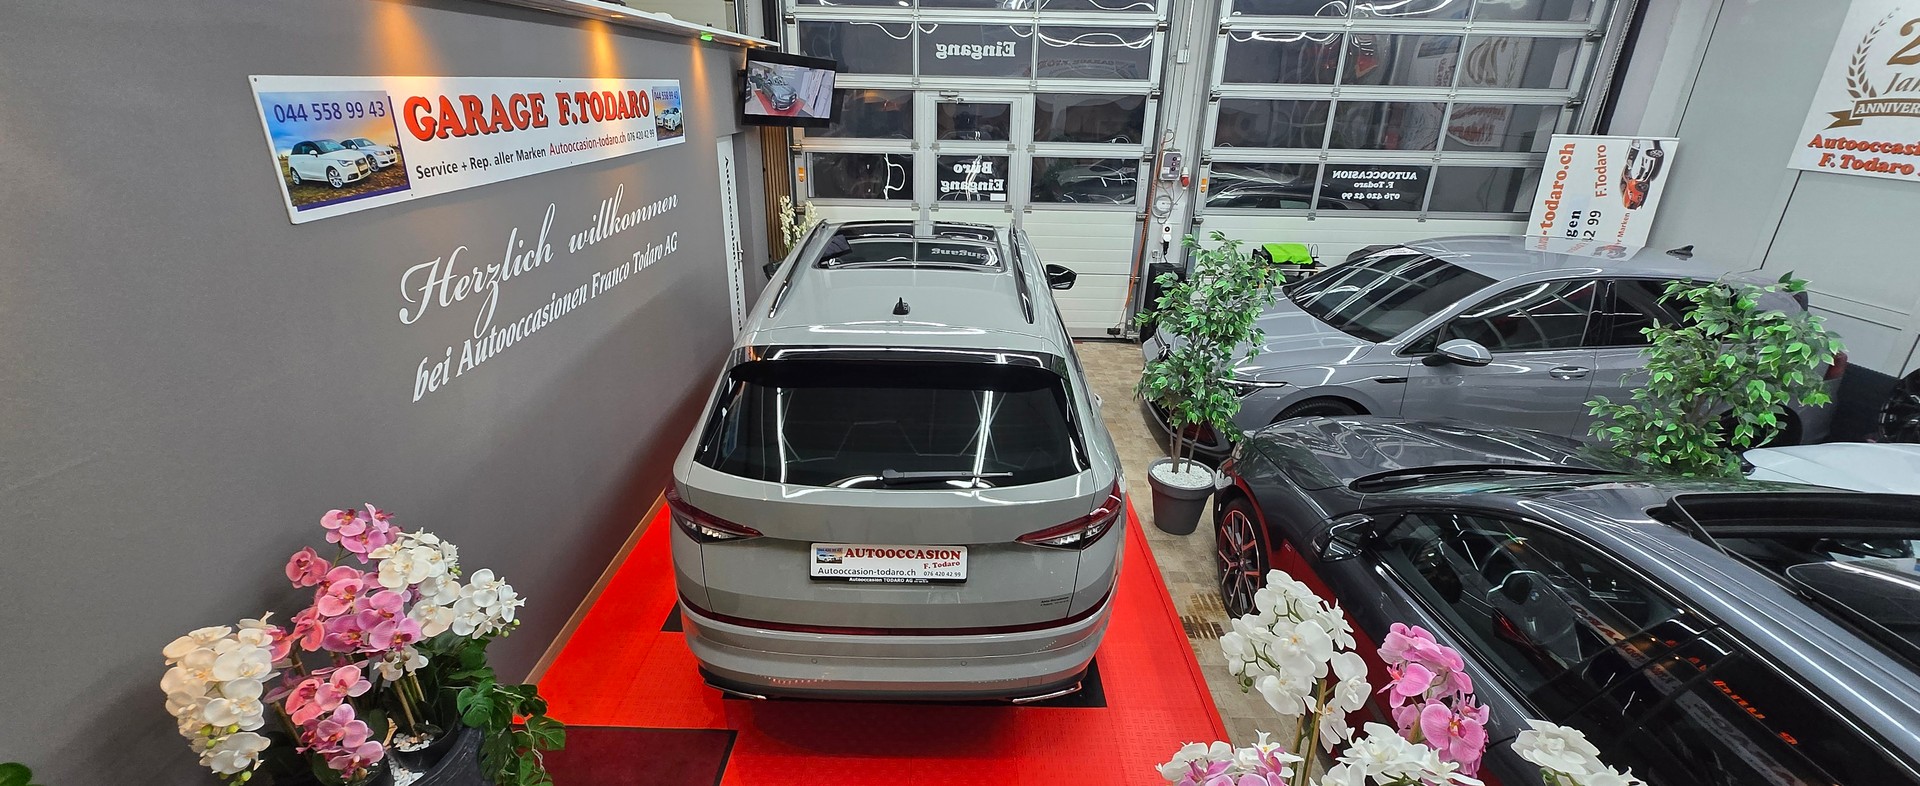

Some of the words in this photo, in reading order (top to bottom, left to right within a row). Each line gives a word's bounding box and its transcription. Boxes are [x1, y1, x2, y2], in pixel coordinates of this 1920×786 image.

[273, 103, 308, 123] 044
[311, 102, 343, 121] 558
[345, 101, 364, 119] 99
[368, 100, 385, 118] 43
[403, 92, 549, 142] GARAGE
[555, 89, 650, 126] F.TODARO
[416, 160, 459, 180] Service
[461, 161, 467, 171] +
[469, 155, 492, 171] Rep.
[494, 151, 514, 166] aller
[515, 146, 547, 162] Marken
[549, 131, 626, 156] Autooccasion-todaro.ch
[626, 131, 635, 142] 076
[635, 130, 644, 140] 420
[643, 129, 649, 139] 42
[649, 128, 655, 138] 99
[1818, 152, 1835, 168] F.
[1839, 154, 1915, 175] Todaro
[1594, 144, 1608, 198] F.Todaro
[1566, 210, 1582, 239] gen
[1587, 210, 1602, 226] 99
[1616, 212, 1630, 238] Marken
[399, 203, 556, 339] Herzlich
[568, 183, 678, 254] willkommen
[412, 346, 453, 403] bei
[456, 284, 588, 379] Autooccasionen
[590, 261, 630, 300] Franco
[632, 243, 663, 275] Todaro
[663, 231, 678, 257] AG
[844, 547, 961, 560] AUTOOCCASION
[932, 561, 961, 569] Todaro
[817, 567, 916, 576] Autooccasion-todaro.ch
